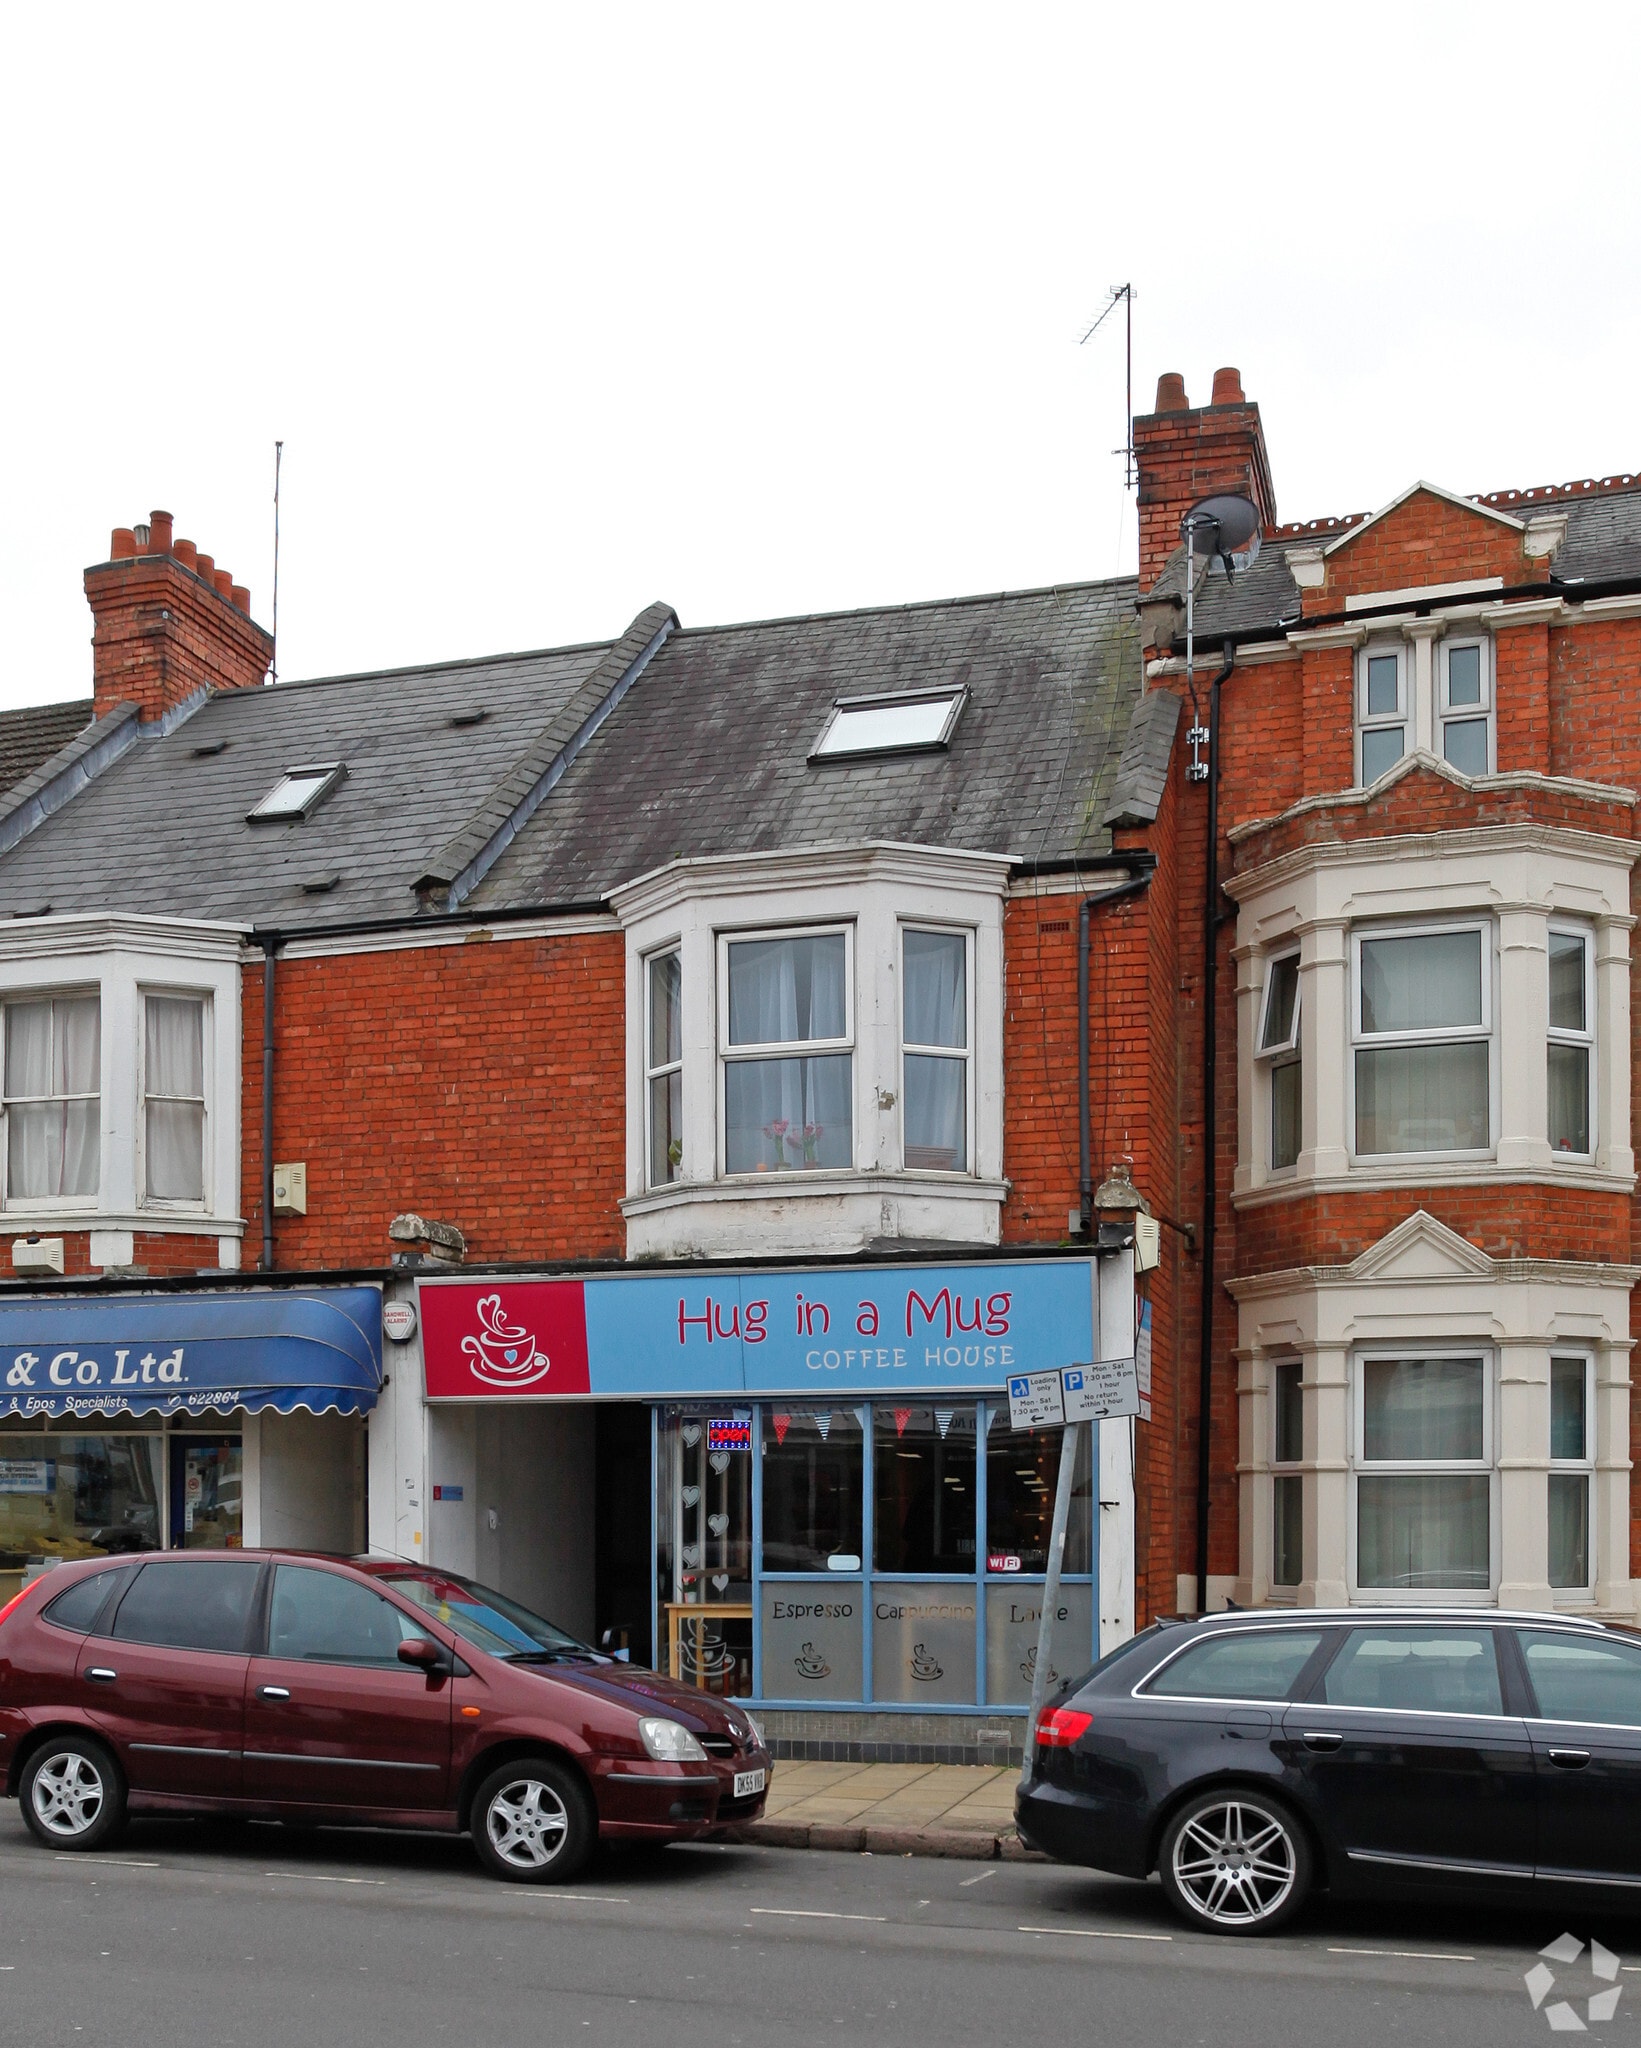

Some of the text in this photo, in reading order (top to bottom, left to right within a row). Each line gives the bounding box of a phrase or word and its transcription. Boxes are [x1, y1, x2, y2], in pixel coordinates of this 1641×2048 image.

[677, 1286, 1013, 1344] Hug in a Mug
[806, 1345, 1015, 1370] COFFEE HOUSE
[6, 1348, 190, 1386] & Co. Ltd.
[1092, 1365, 1107, 1373] Mon
[1112, 1362, 1124, 1370] Sat
[1030, 1376, 1057, 1386] Loading
[1084, 1374, 1101, 1382] 7.30
[1122, 1370, 1134, 1378] pm
[1036, 1383, 1051, 1392] only
[1095, 1391, 1118, 1399] return
[9, 1395, 128, 1412] & Epos Specialists
[188, 1390, 240, 1406] 622864
[1020, 1399, 1034, 1407] Mon
[1040, 1397, 1051, 1405] Sat
[1080, 1400, 1101, 1409] within
[1106, 1397, 1124, 1405] hour
[1049, 1405, 1060, 1413] pm
[709, 1428, 750, 1444] open
[773, 1601, 853, 1619] Espresso
[875, 1603, 975, 1619] Cappuccino
[1010, 1604, 1068, 1623] Lae
